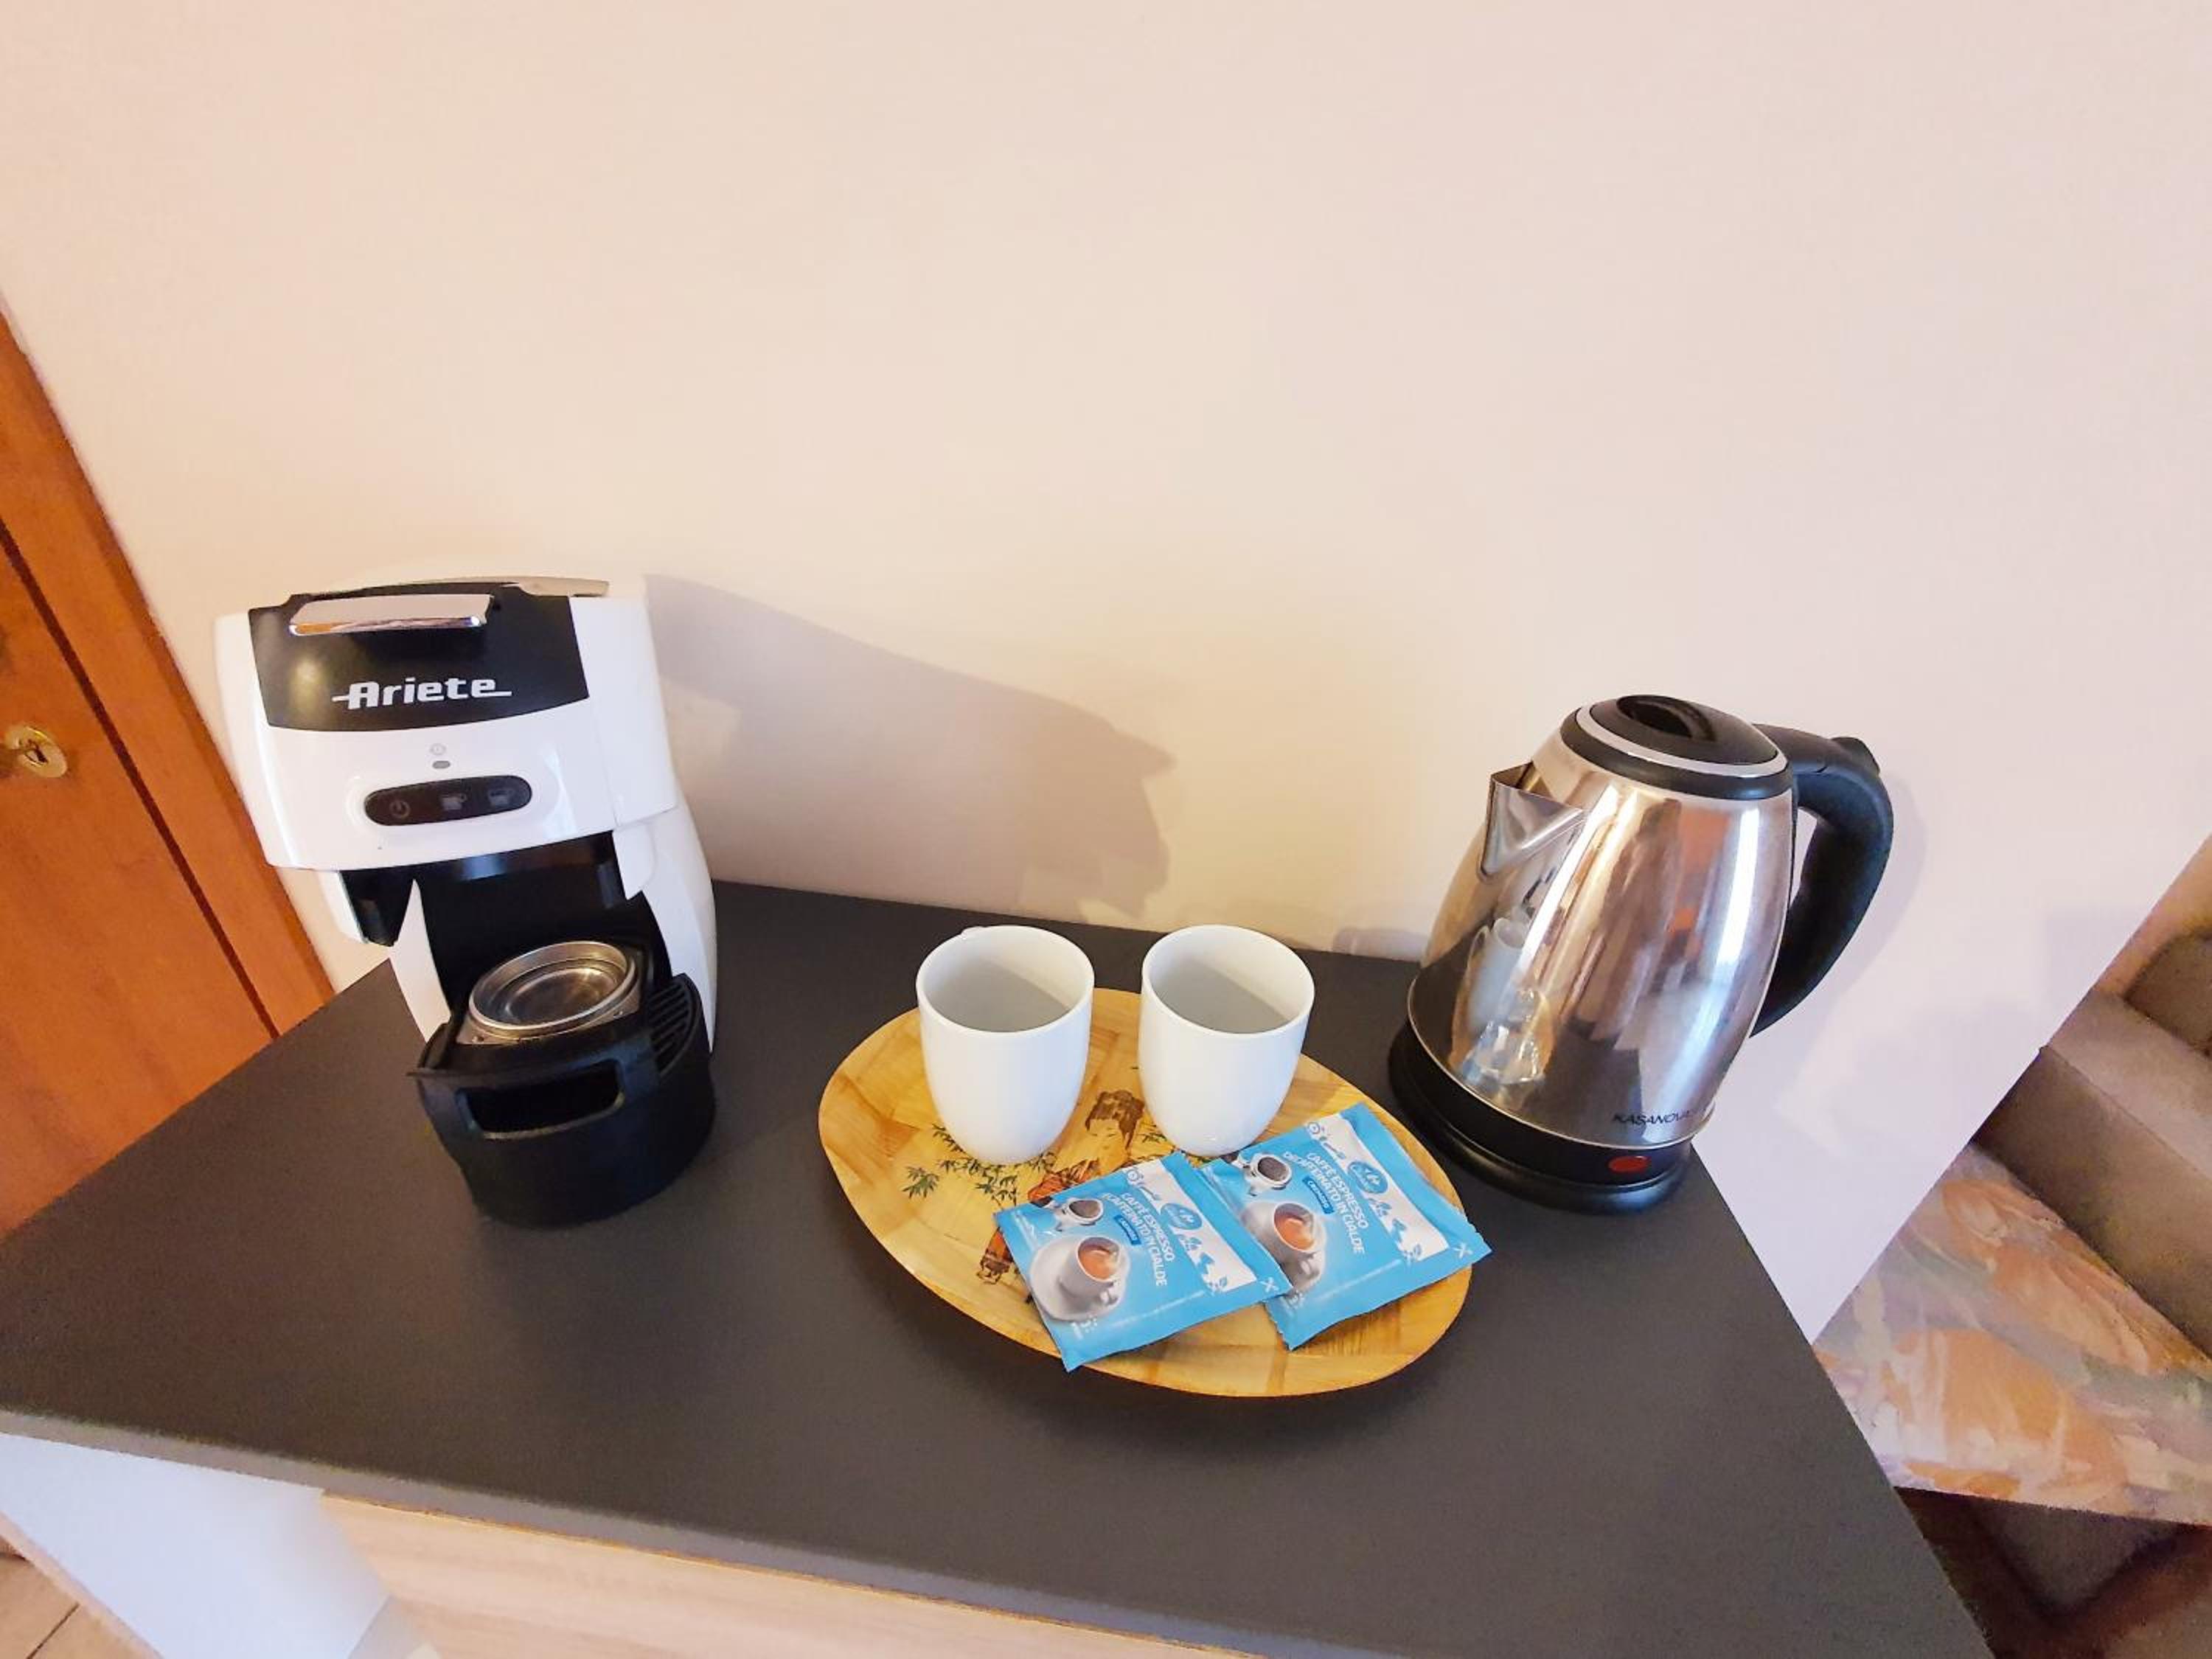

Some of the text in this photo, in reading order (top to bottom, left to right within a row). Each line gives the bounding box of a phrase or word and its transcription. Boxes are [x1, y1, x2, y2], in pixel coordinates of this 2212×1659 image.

[332, 677, 512, 709] Ariete
[1282, 1151, 1341, 1201] DECAFFEINATO
[1335, 1202, 1350, 1215] IN
[1343, 1214, 1366, 1254] CIALDE
[1332, 1175, 1368, 1229] ESPRESSO
[1144, 1214, 1175, 1262] ESPRESSO
[1149, 1245, 1168, 1287] CIALDE
